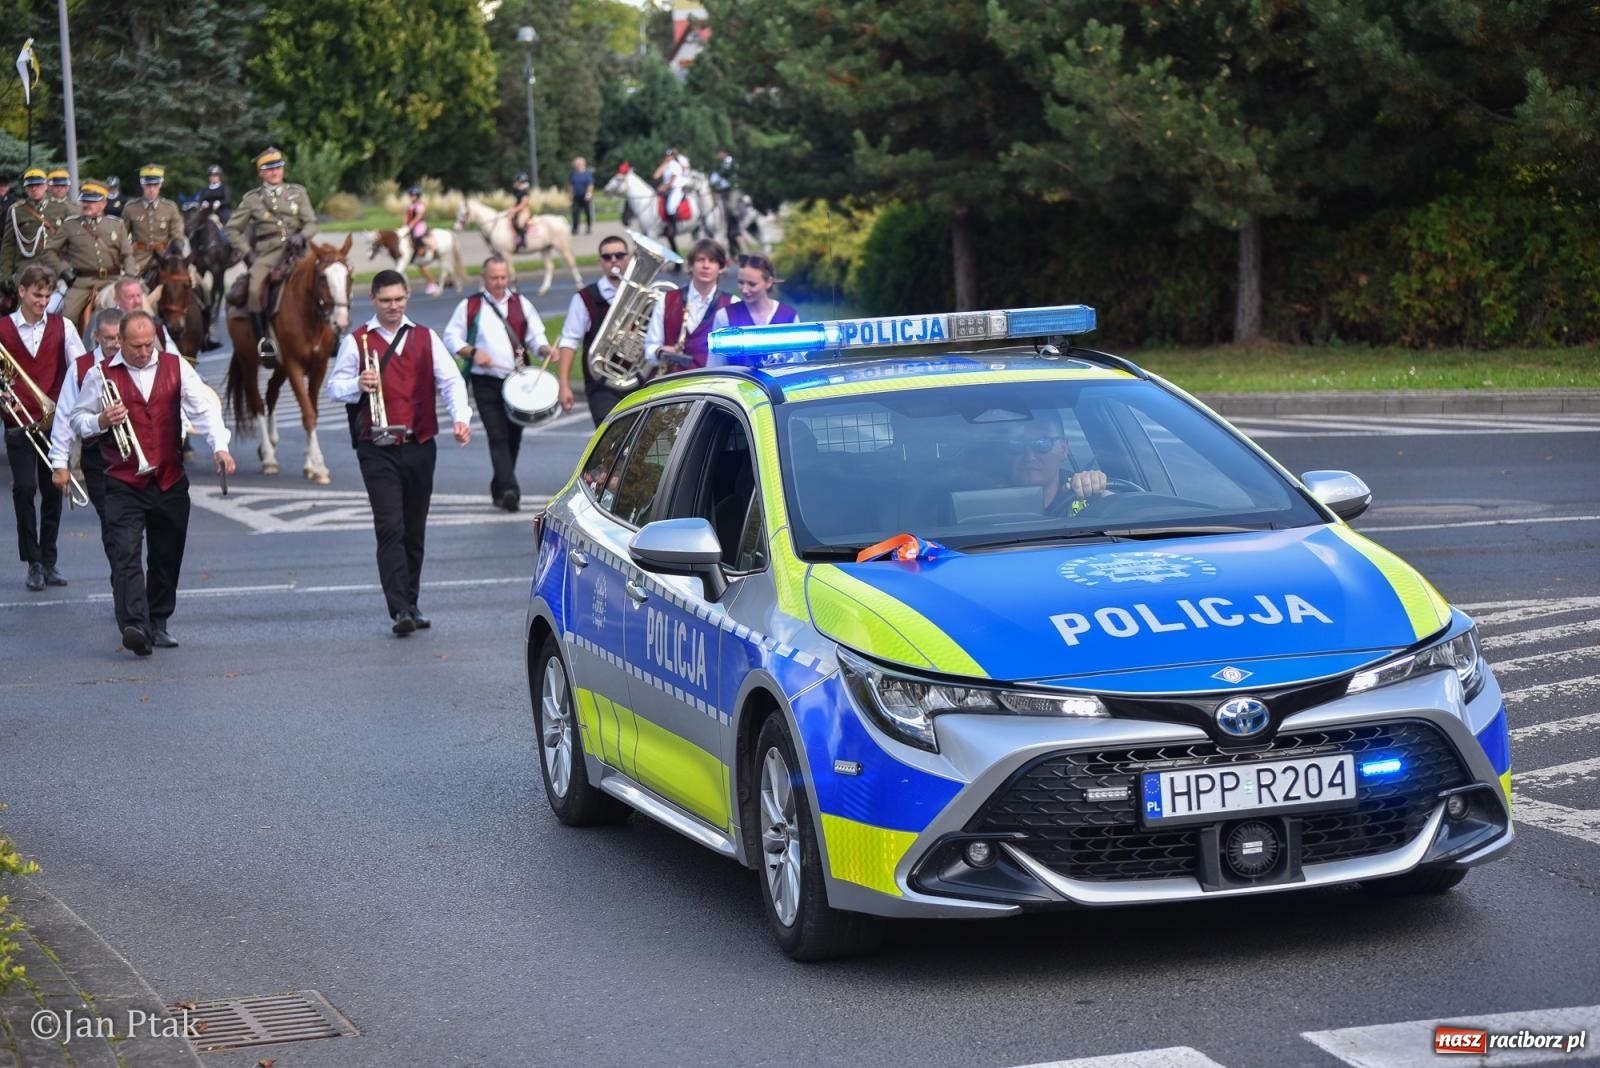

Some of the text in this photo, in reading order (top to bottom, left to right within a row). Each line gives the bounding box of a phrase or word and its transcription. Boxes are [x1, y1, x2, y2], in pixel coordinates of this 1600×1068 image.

[846, 316, 945, 346] POLICJA
[1049, 594, 1334, 646] POLICJA
[646, 606, 708, 691] POLICJA
[1147, 801, 1161, 812] PL
[1169, 759, 1347, 813] HPP R204
